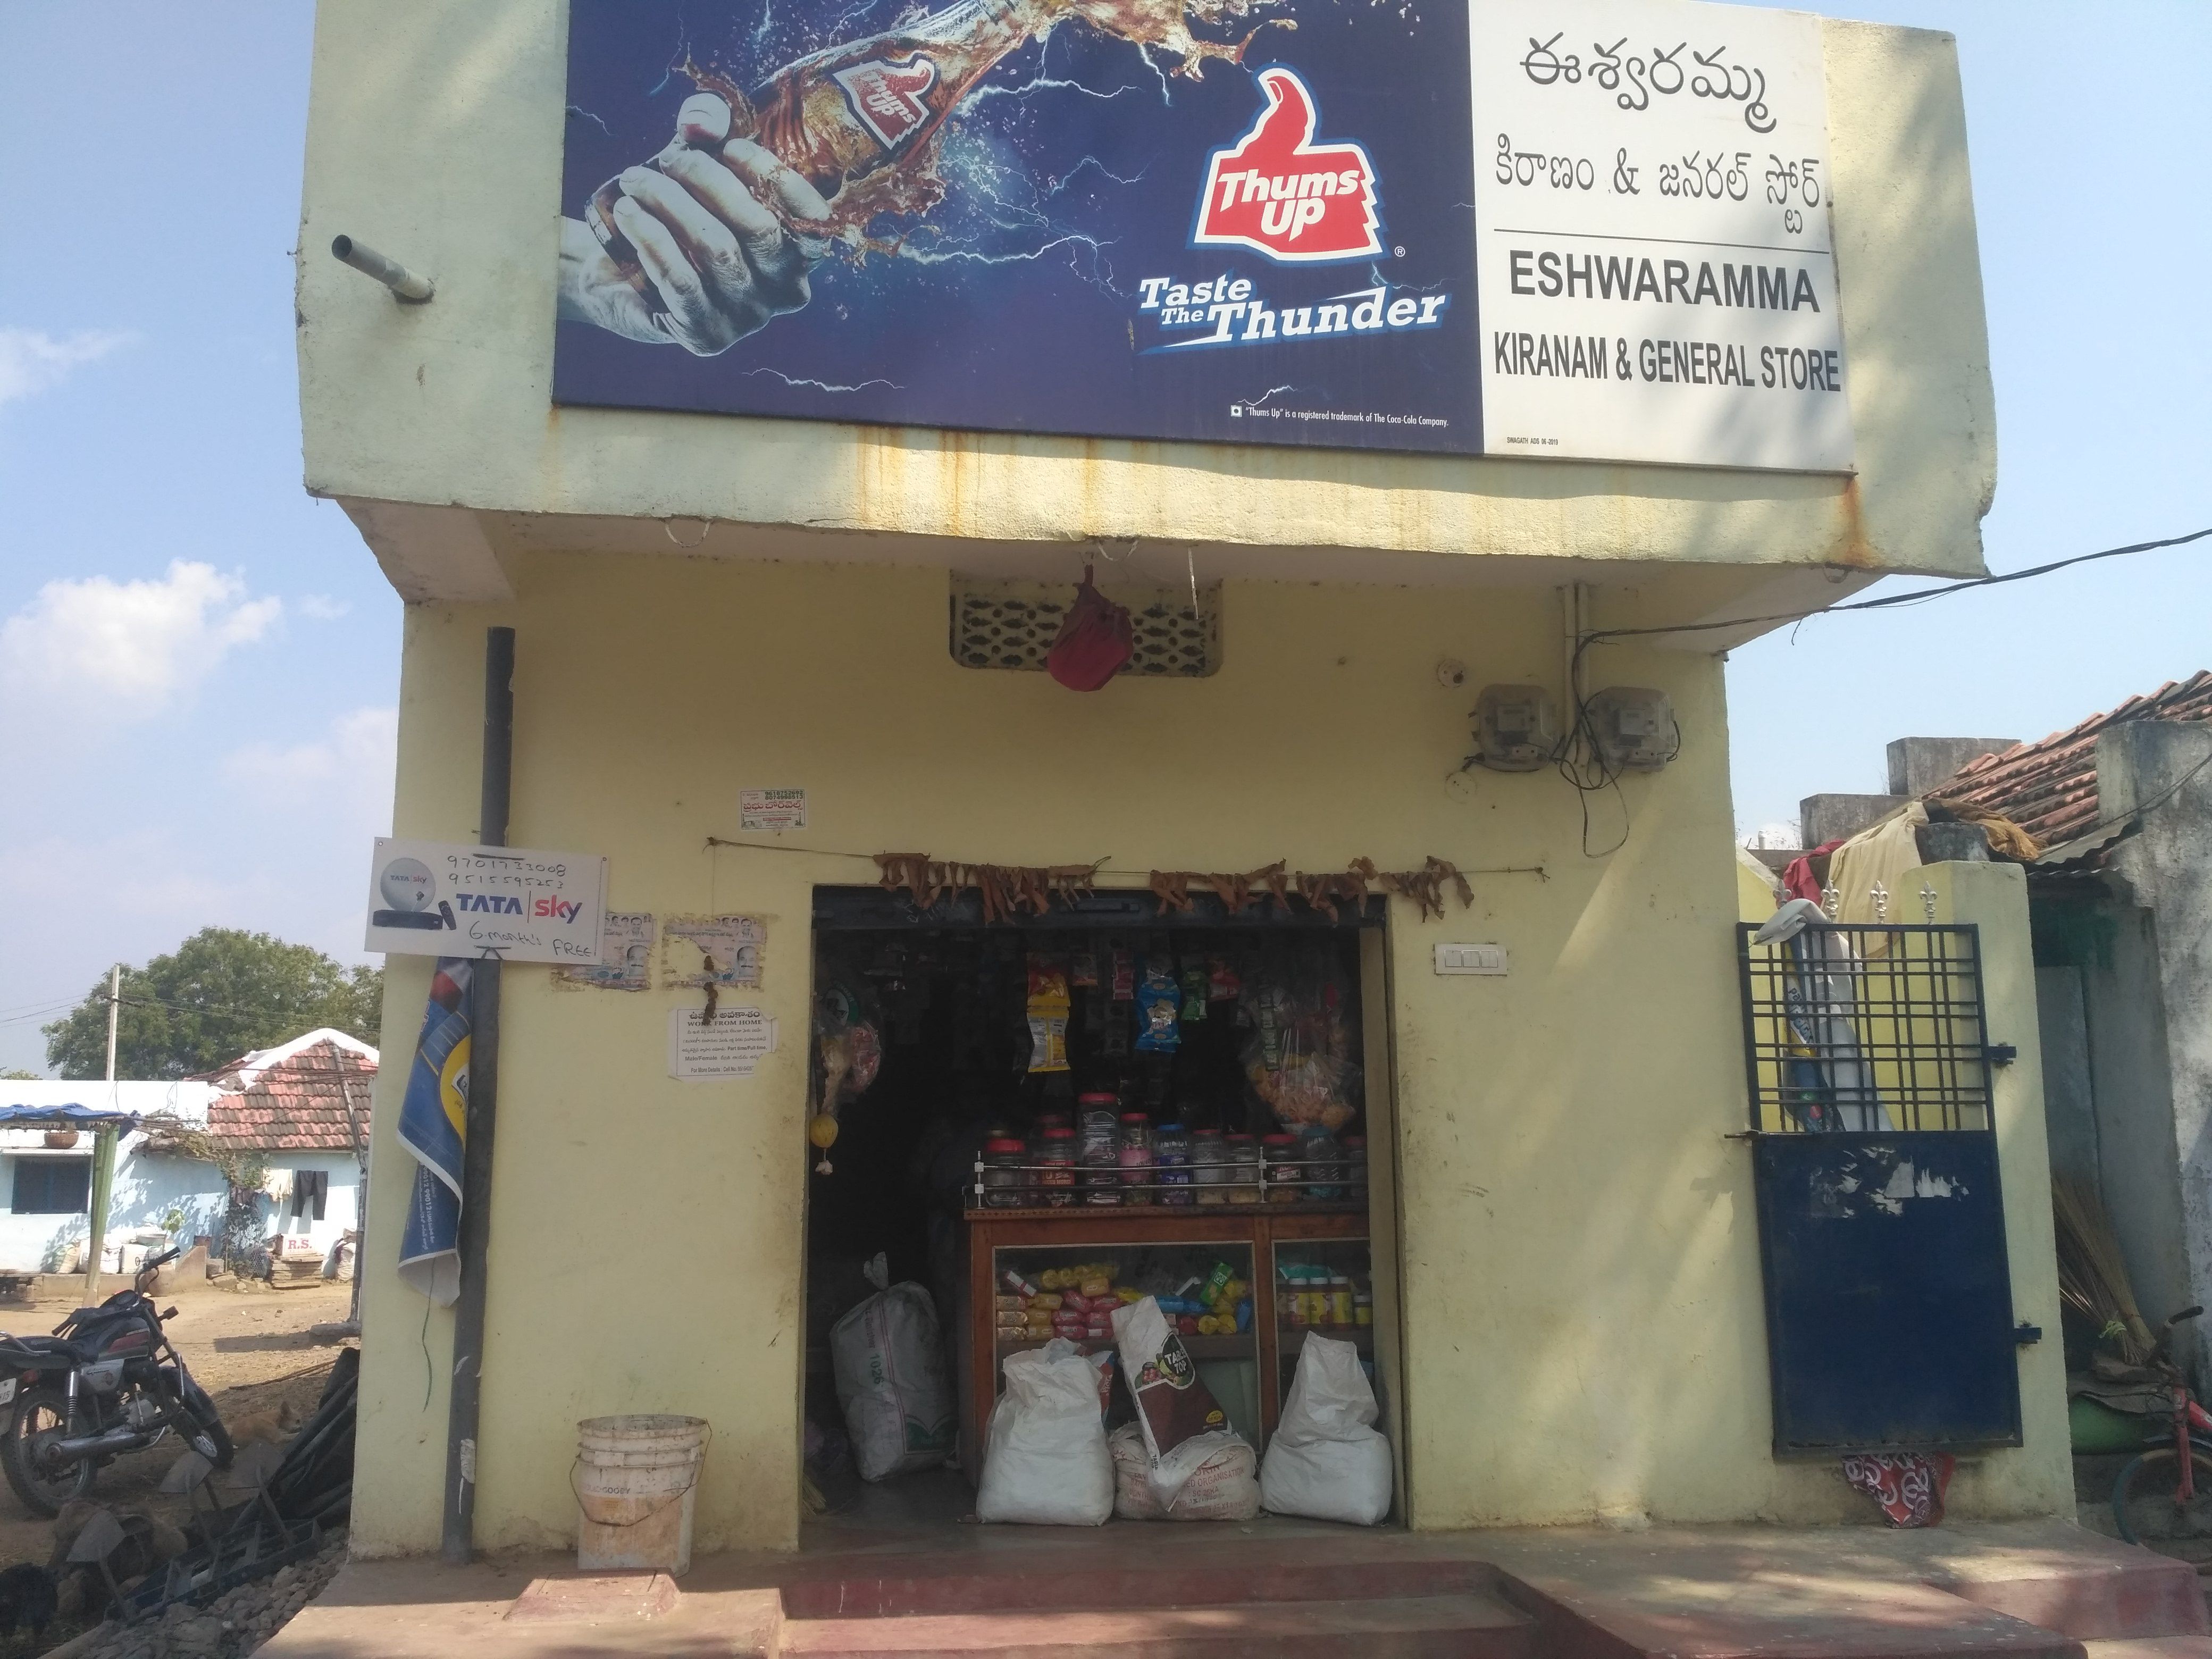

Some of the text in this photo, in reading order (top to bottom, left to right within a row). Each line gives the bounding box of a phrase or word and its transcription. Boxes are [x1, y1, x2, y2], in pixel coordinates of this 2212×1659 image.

[1520, 31, 1777, 133] ఈశ్వరమ్మ
[1218, 169, 1360, 212] Thums
[1496, 133, 1820, 234] కిరాణం & జనరల్ స్టోర్
[1139, 274, 1251, 309] Taste
[1510, 250, 1820, 313] ESHWARAMMA
[1161, 287, 1445, 347] The Thunder
[1494, 331, 1841, 392] KIRANAM & GENERAL STORE
[1285, 409, 1291, 418] is
[1298, 410, 1329, 422] registered
[1331, 412, 1364, 422] trademark
[1365, 412, 1372, 422] of
[1374, 413, 1385, 423] The
[1387, 414, 1417, 425] Coca-Cola
[1419, 416, 1449, 428] Company.
[448, 855, 566, 877] 9701733008
[448, 873, 564, 889] 9515595253
[456, 893, 583, 924] TATA sky
[552, 939, 592, 958] FREE
[1174, 1360, 1187, 1374] TOP
[1197, 1466, 1244, 1487] ORGANISATION
